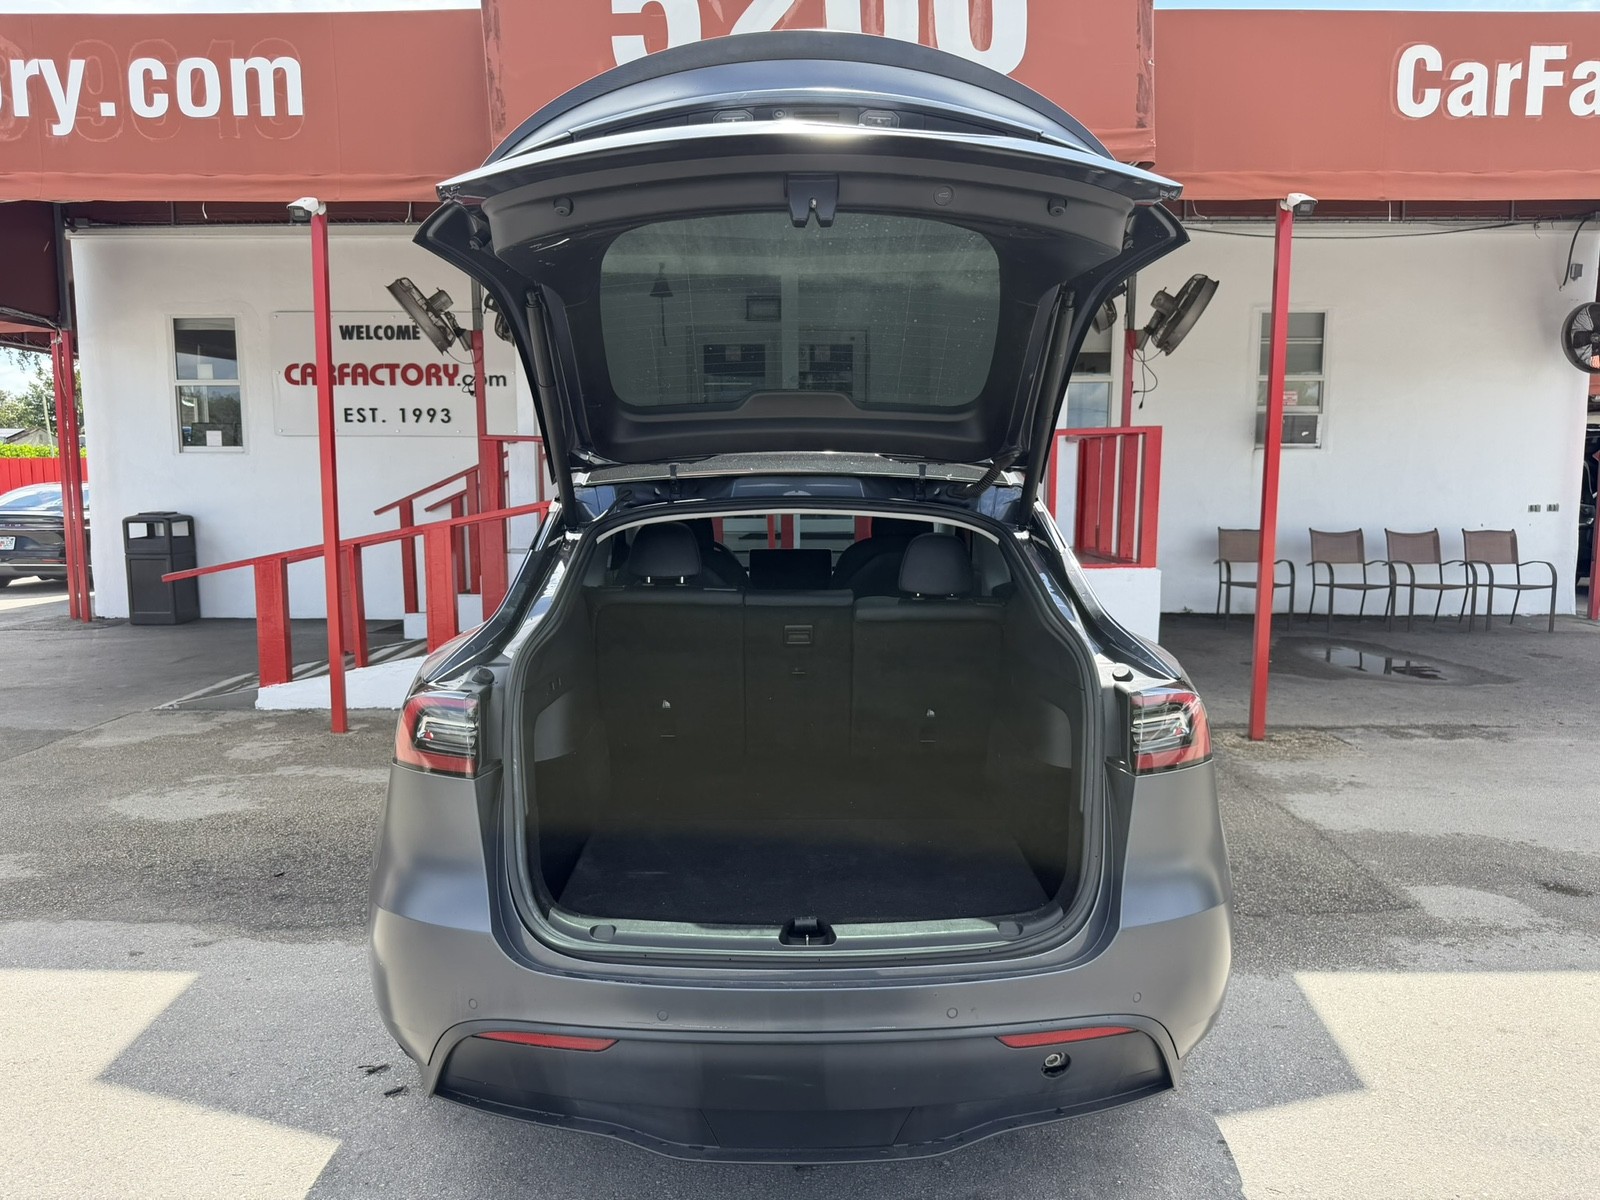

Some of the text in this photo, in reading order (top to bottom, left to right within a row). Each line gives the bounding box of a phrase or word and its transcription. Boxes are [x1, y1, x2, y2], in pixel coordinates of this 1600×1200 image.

[1396, 44, 1600, 118] CarFa
[0, 56, 304, 136] ry.com
[339, 324, 421, 341] WELCOME
[284, 362, 507, 387] CAFACTORY.cm
[344, 407, 452, 424] EST. 1993
